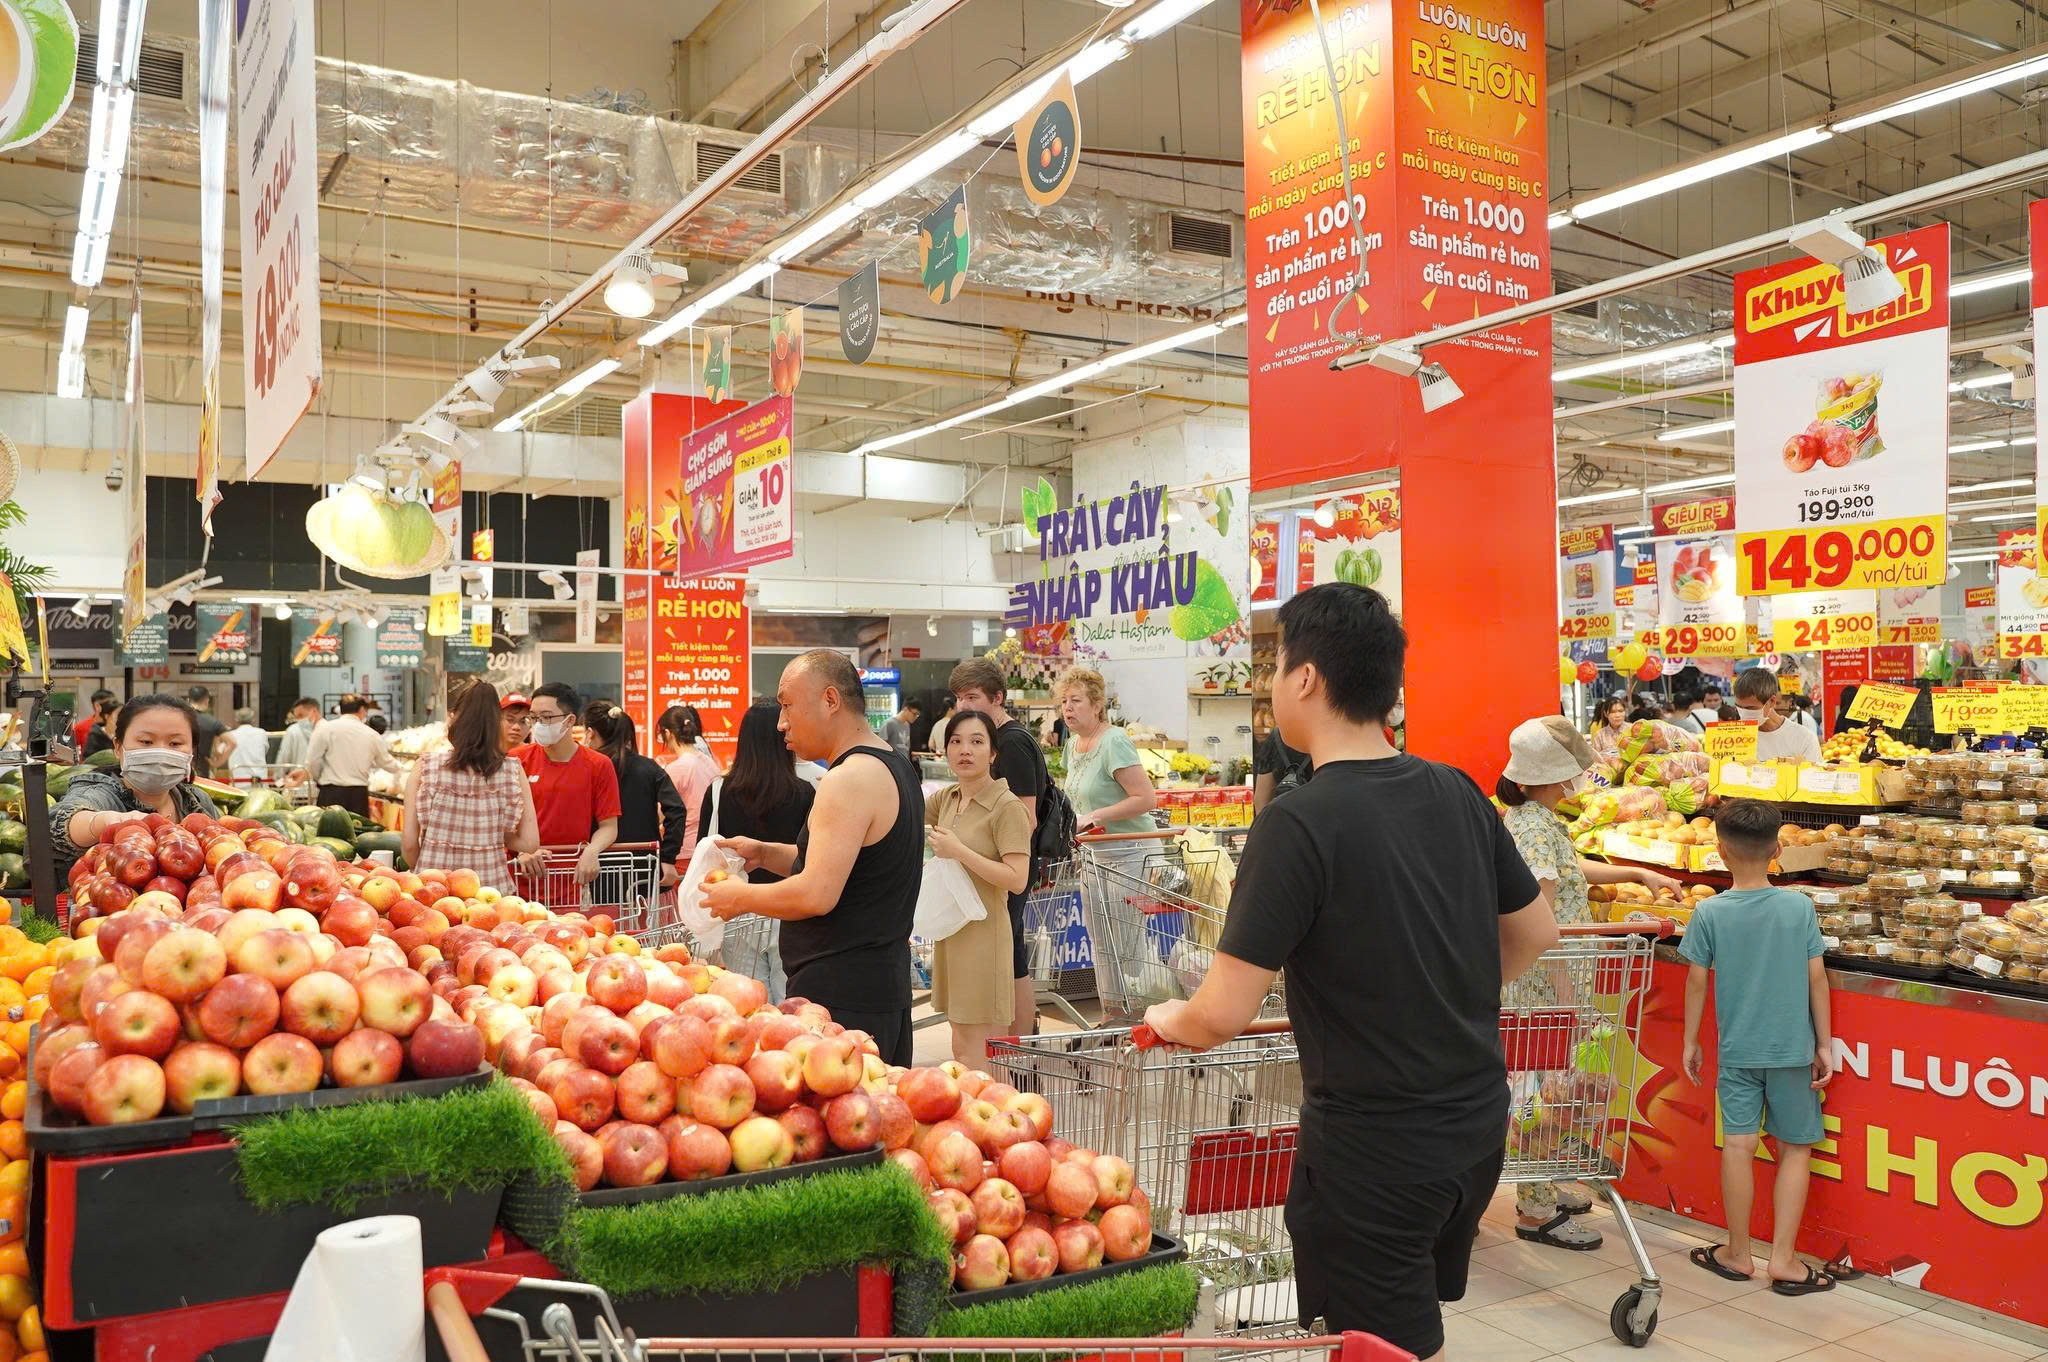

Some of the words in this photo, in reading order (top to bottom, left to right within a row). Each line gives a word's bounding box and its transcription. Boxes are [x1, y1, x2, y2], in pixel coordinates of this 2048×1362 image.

[1418, 0, 1471, 34] LUÔN
[1476, 18, 1527, 51] LUÔN
[1257, 71, 1299, 129] RẺ
[1303, 39, 1380, 109] HƠN
[1411, 34, 1456, 88] RẺ
[1462, 53, 1537, 107] HƠN
[1269, 161, 1295, 187] Tiết
[1298, 151, 1330, 179] kiệm
[1334, 137, 1361, 162] hơn
[1425, 127, 1454, 150] Tiết
[1457, 139, 1490, 160] kiệm
[1493, 148, 1520, 167] hơn
[254, 182, 272, 257] TÁO
[273, 116, 297, 215] GALA
[1249, 195, 1273, 221] mỗi
[1276, 184, 1307, 212] ngày
[1310, 171, 1345, 199] cùng
[1348, 158, 1372, 181] Big
[1375, 151, 1386, 169] C
[1402, 150, 1429, 170] mỗi
[1432, 158, 1466, 184] ngày
[1471, 165, 1504, 192] cùng
[1508, 174, 1530, 197] Big
[1532, 181, 1542, 198] C
[1265, 225, 1300, 255] Trên
[1304, 193, 1366, 240] 1.000
[1422, 194, 1459, 222] Trên
[1464, 197, 1525, 236] 1.000
[1255, 262, 1280, 288] sản
[1284, 245, 1327, 283] phẩm
[1330, 238, 1348, 262] rẻ
[1351, 231, 1382, 258] hơn
[1409, 224, 1438, 250] sản
[1441, 229, 1487, 261] phẩm
[1490, 241, 1506, 263] rẻ
[1510, 247, 1540, 271] hơn
[1267, 289, 1295, 317] đến
[1298, 274, 1332, 305] cuối
[1335, 270, 1370, 295] năm
[1423, 259, 1453, 287] đến
[1457, 268, 1492, 293] cuối
[1495, 279, 1528, 300] năm
[688, 443, 707, 472] CHỢ
[1804, 488, 1819, 497] Táo
[1821, 487, 1837, 496] Fuji
[1839, 484, 1850, 494] túi
[1853, 483, 1870, 492] 3Kg
[1037, 493, 1104, 562] TRÁI
[1106, 480, 1167, 546] CÂY
[1668, 505, 1697, 526] SIÊU
[1110, 523, 1198, 615] KHẨU
[1743, 524, 1935, 591] 149.000
[701, 578, 736, 591] LUÔN
[657, 592, 688, 617] RẺ
[691, 599, 742, 619] HƠN
[1082, 619, 1116, 643] Dalat
[1120, 616, 1172, 643] Hasfarm
[1665, 626, 1737, 655] 29.900
[1794, 616, 1874, 648] 24.900
[668, 671, 691, 681] Trên
[693, 668, 731, 681] 1.000
[720, 655, 734, 664] Big
[736, 655, 742, 663] C
[869, 669, 895, 681] pepsi
[660, 686, 677, 695] sản
[679, 682, 706, 697] phẩm
[720, 685, 739, 696] hơn
[1054, 898, 1087, 929] SẢ
